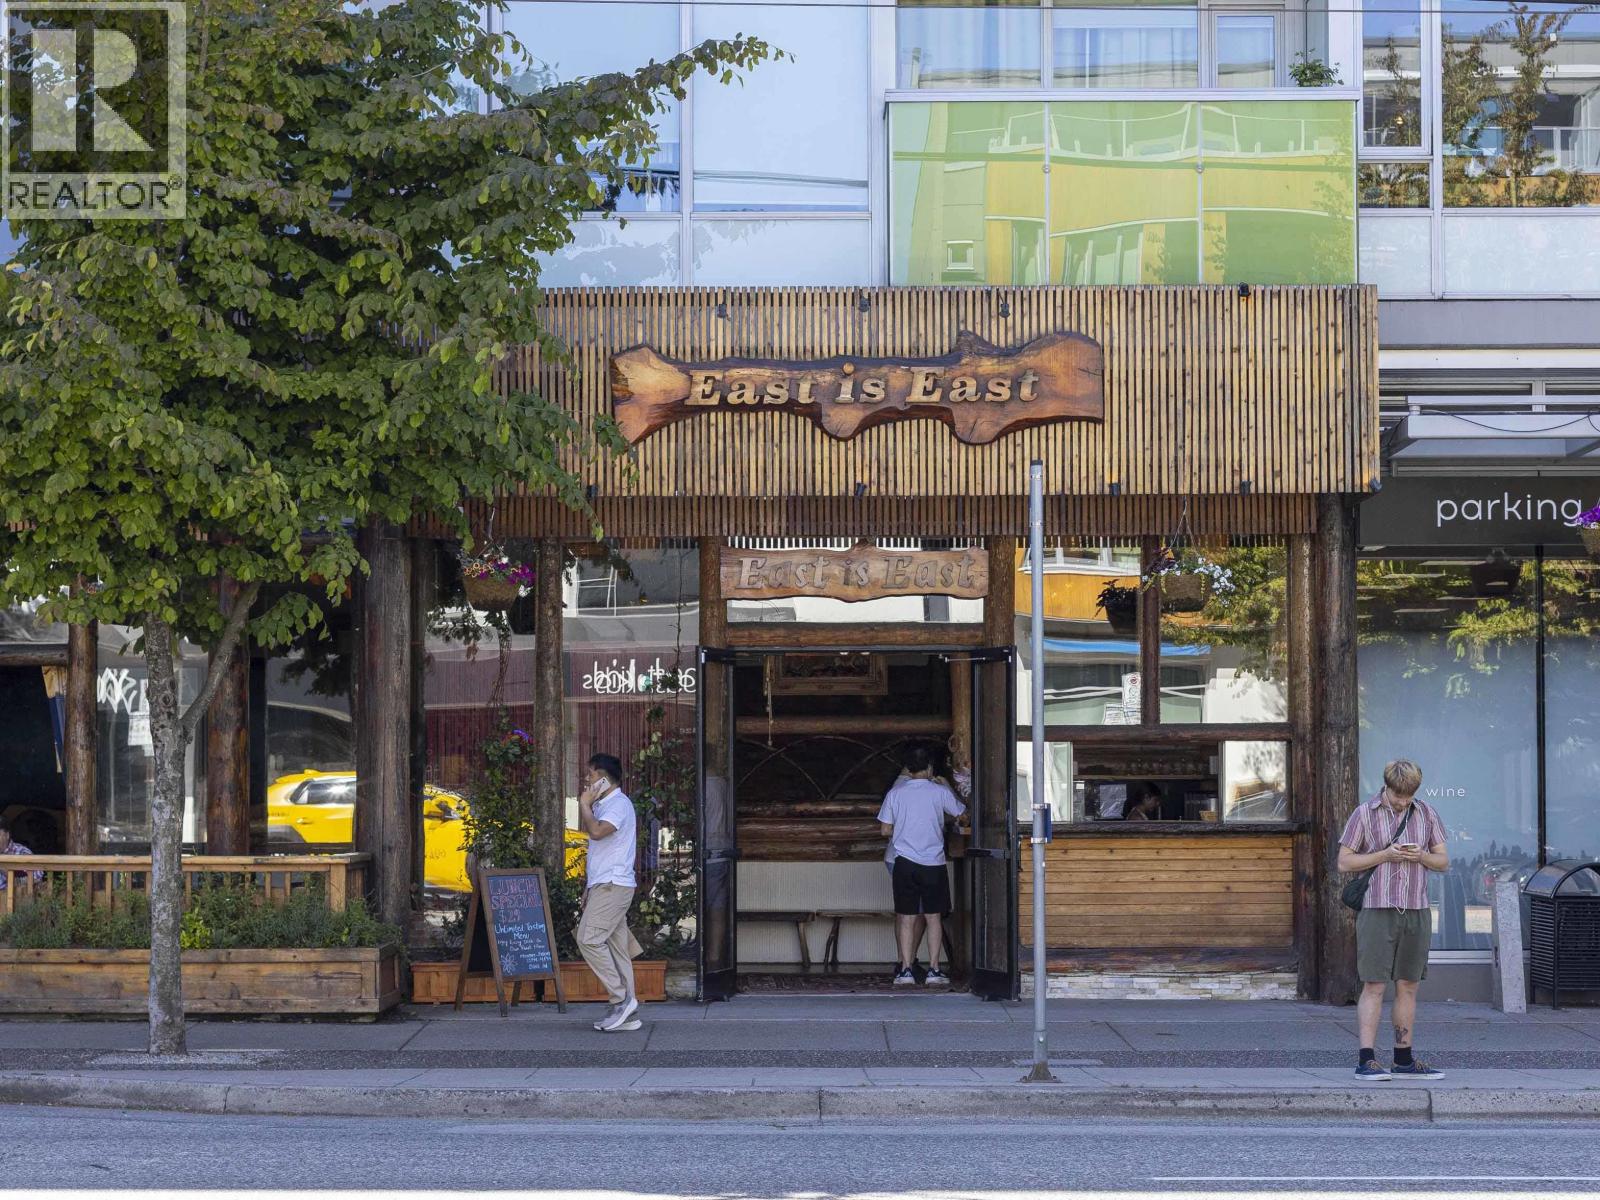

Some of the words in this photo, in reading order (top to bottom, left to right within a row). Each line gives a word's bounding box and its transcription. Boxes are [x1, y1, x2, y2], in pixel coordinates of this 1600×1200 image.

[684, 369, 817, 406] East
[835, 362, 886, 403] is
[904, 366, 1040, 405] East
[1437, 491, 1582, 528] parking
[735, 555, 830, 590] East
[842, 559, 870, 588] is
[881, 554, 976, 589] East
[1425, 786, 1465, 797] wine
[489, 878, 540, 896] LUNCH
[491, 893, 544, 910] SPECIAL
